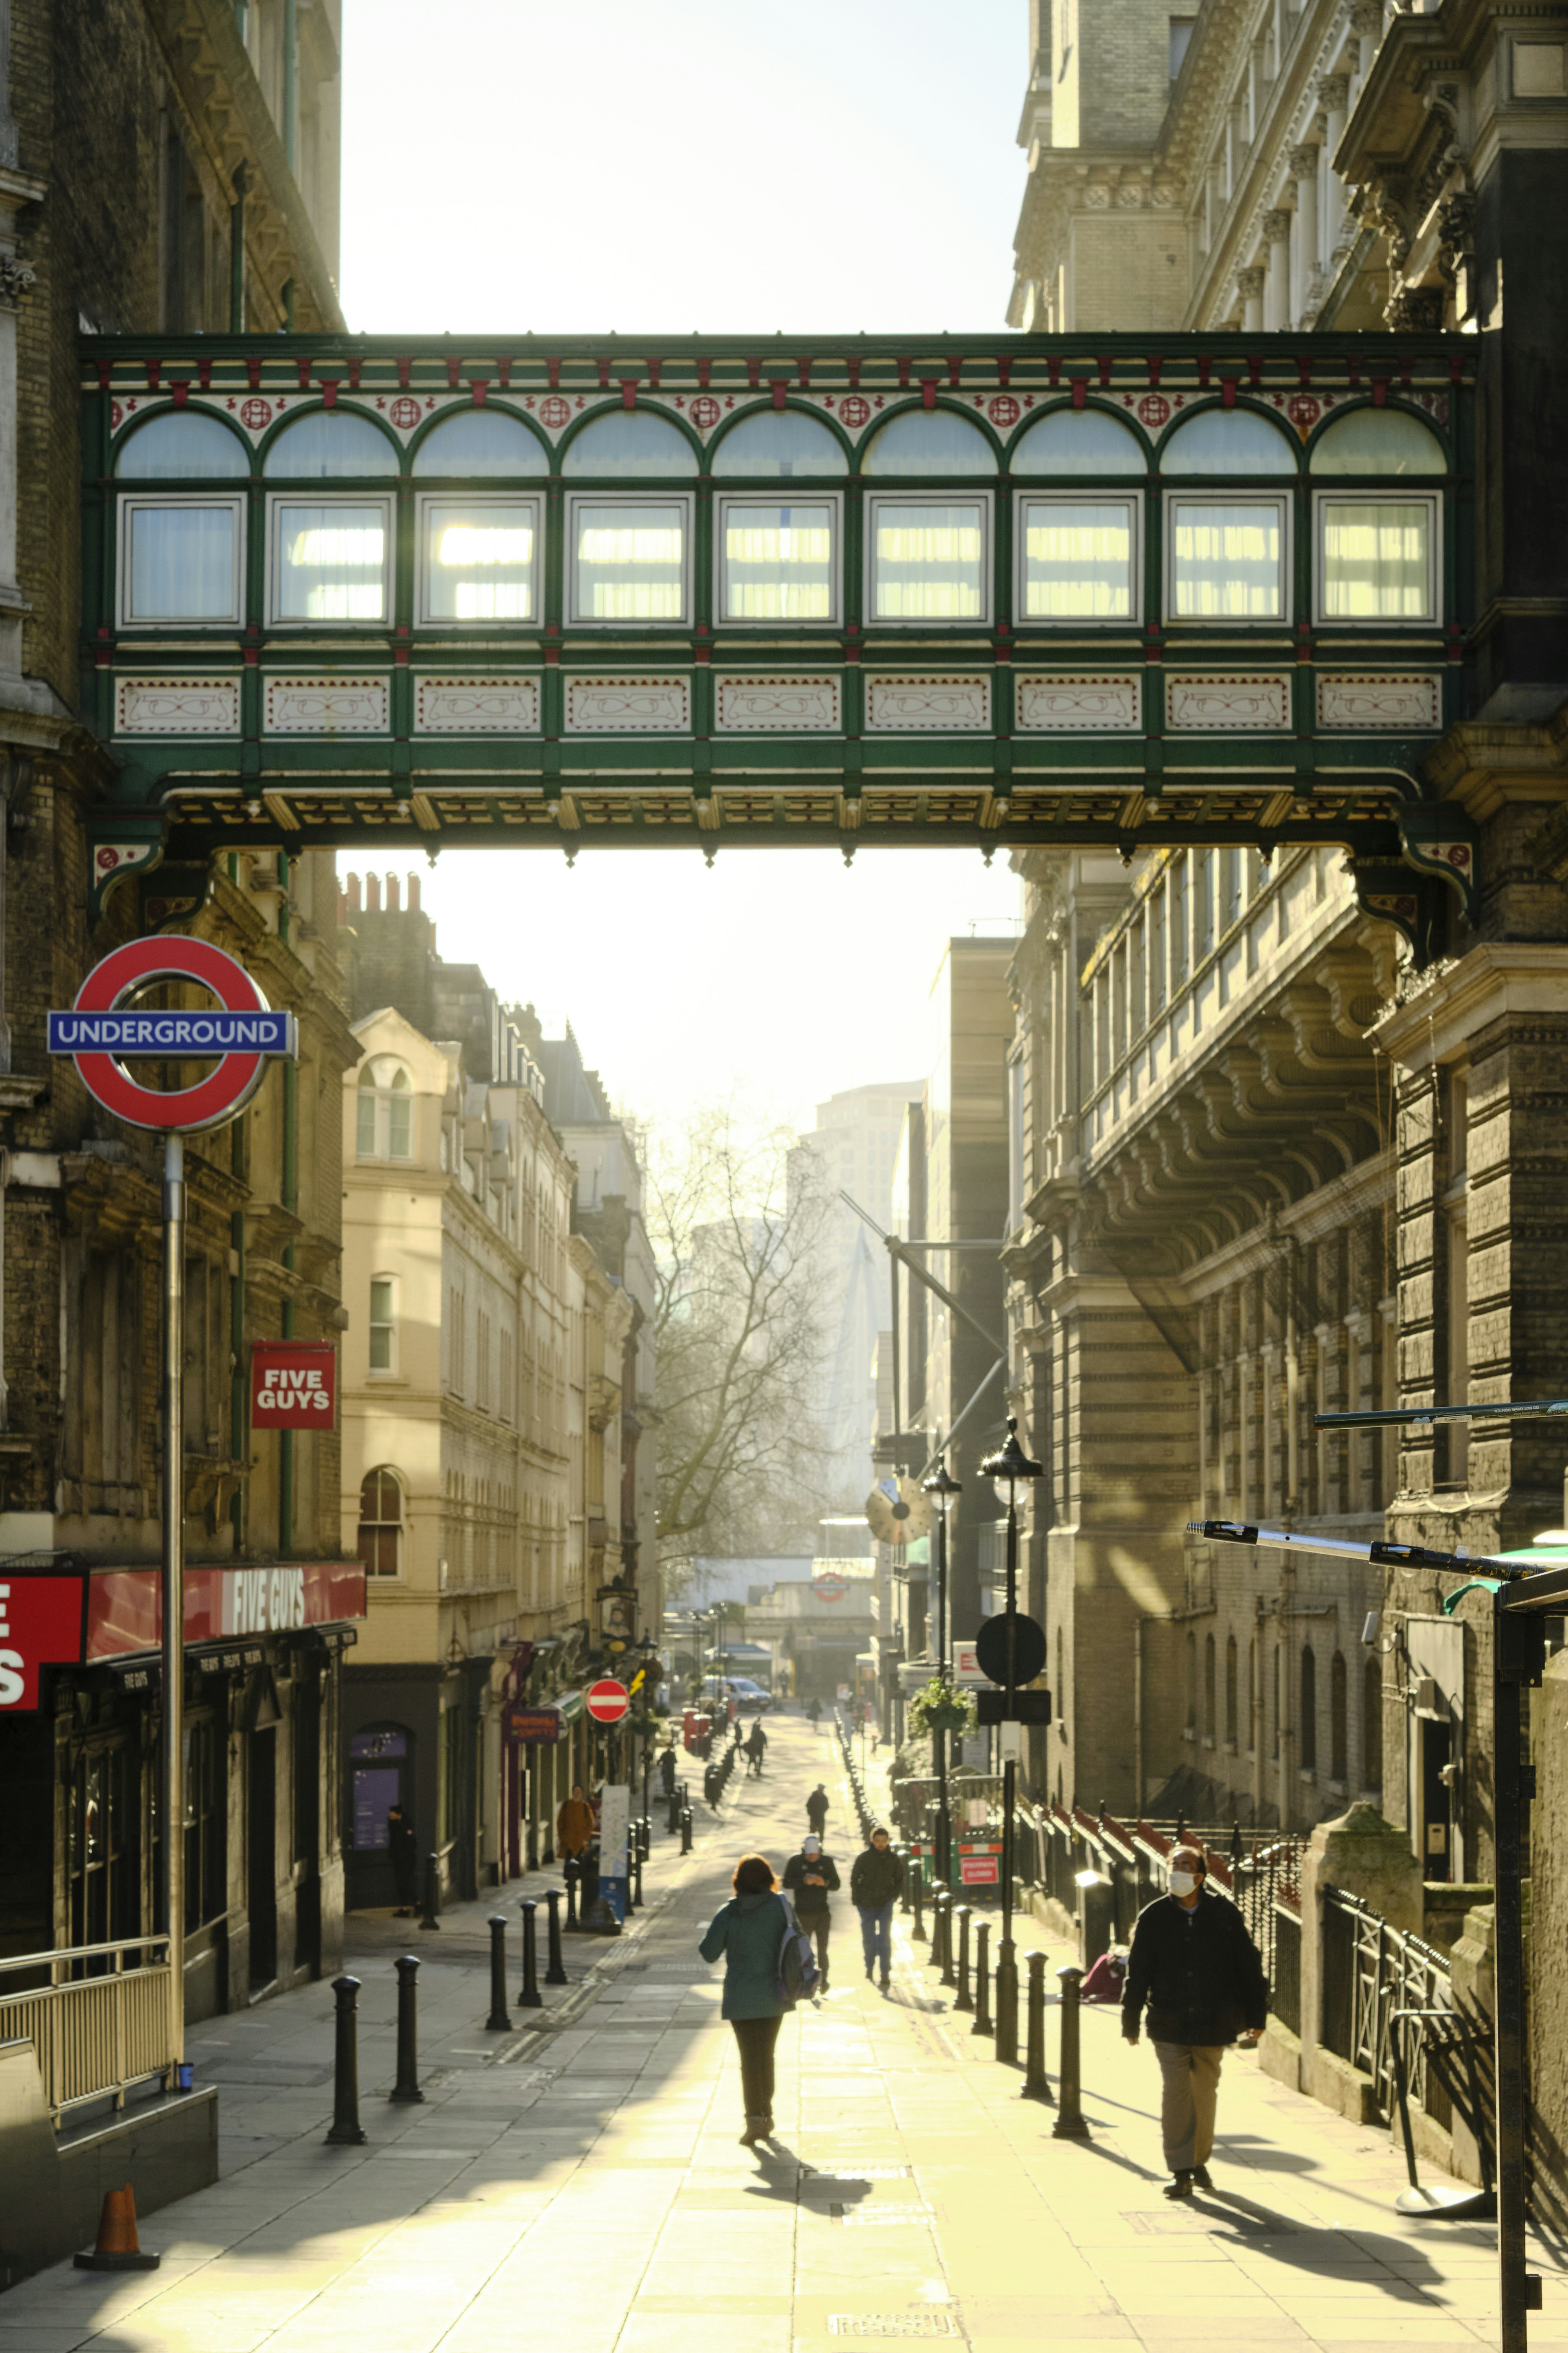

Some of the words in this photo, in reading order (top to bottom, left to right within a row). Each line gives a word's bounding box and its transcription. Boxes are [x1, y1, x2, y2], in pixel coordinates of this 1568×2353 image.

[58, 1021, 278, 1043] UNDERGROUND
[265, 1369, 323, 1389] FIVE
[257, 1390, 330, 1410] GUYS
[233, 1569, 267, 1635] FIVE
[269, 1568, 305, 1631] GUYS
